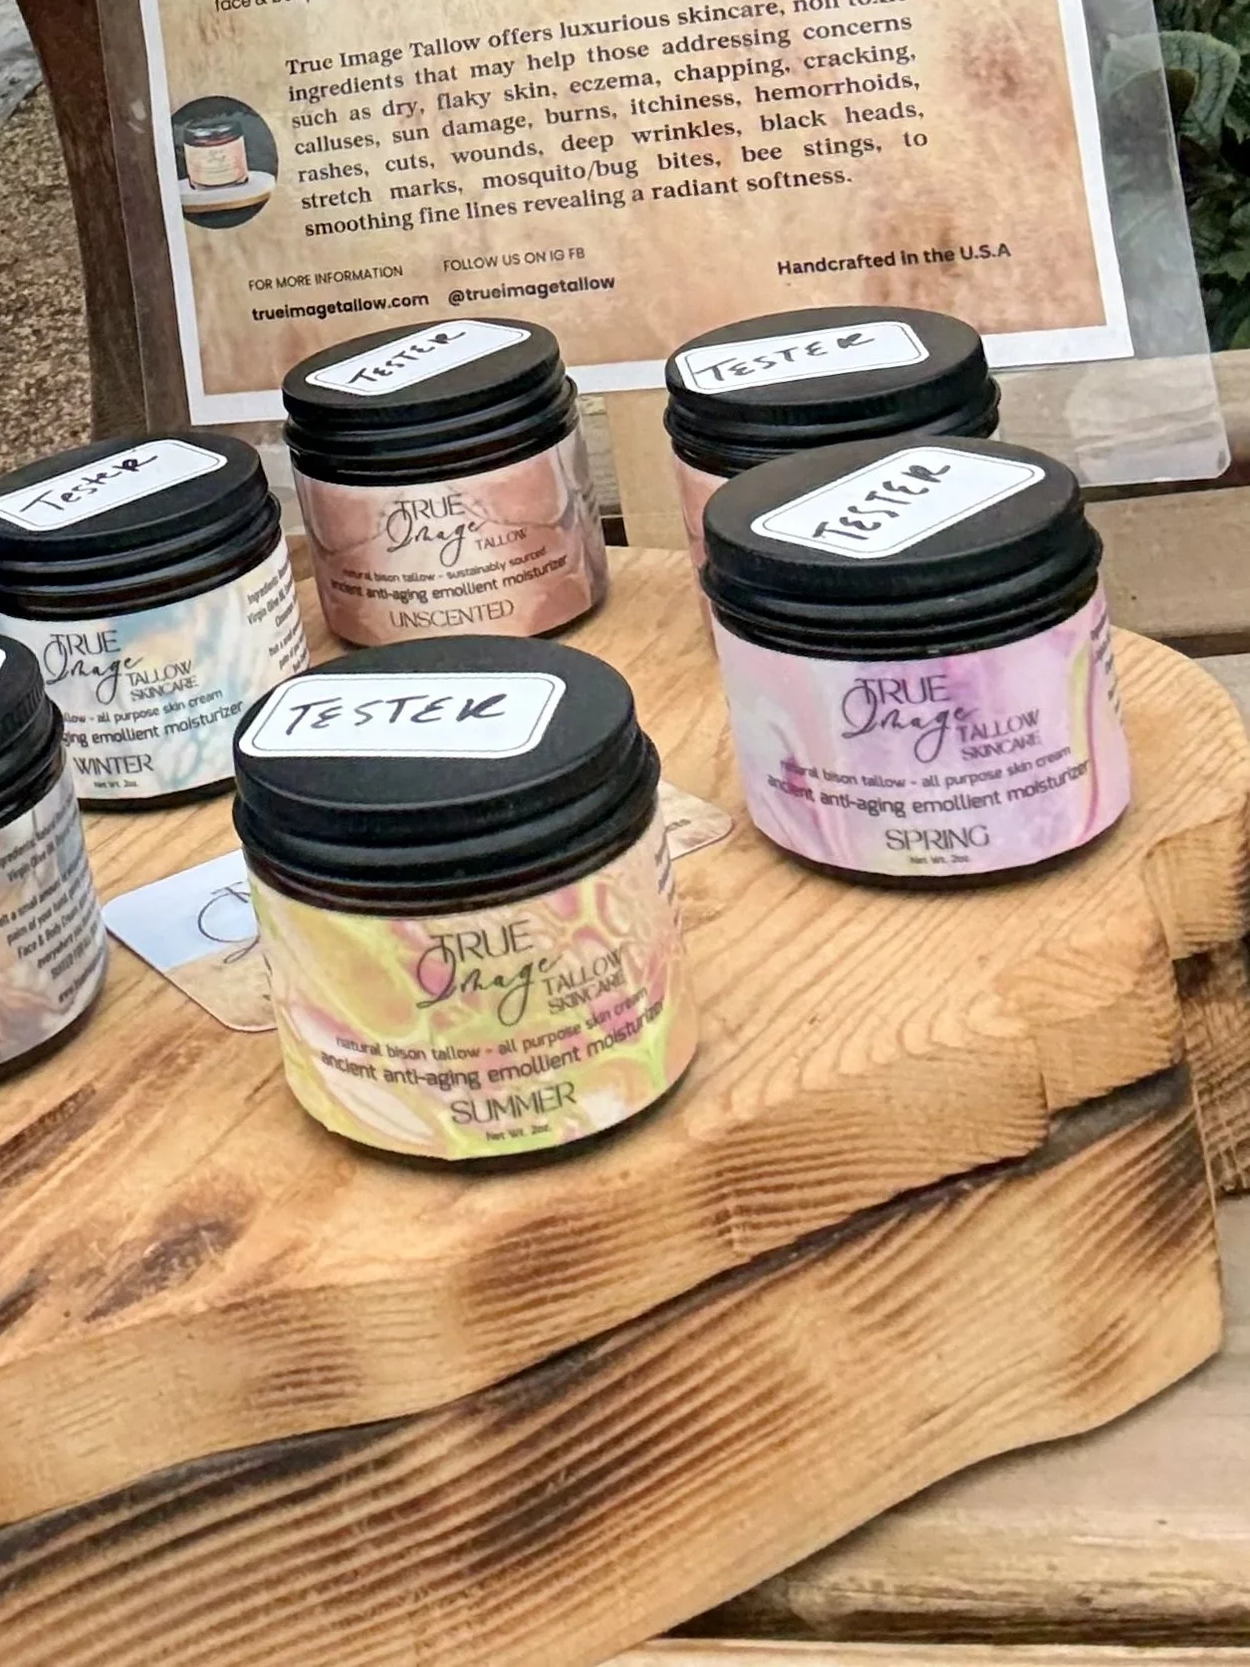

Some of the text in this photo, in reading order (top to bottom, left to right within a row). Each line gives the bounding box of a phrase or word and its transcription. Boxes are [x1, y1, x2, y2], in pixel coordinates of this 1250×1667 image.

[285, 58, 332, 75] True
[339, 48, 402, 67] Image
[409, 37, 480, 58] Tallow
[488, 27, 553, 48] offers
[559, 14, 670, 39] luxurious
[677, 2, 785, 25] skincare,
[289, 17, 912, 104] ingredients that may help those addressing concerns
[292, 45, 915, 129] such as dry, flaky skin, eczema, chapping, cracking,
[294, 72, 919, 155] calluses, sun damage, burns, itchiness, hemorrhoids,
[298, 101, 924, 182] rashes, cuts, wounds, deep wrinkles, black heads,
[301, 132, 927, 209] stretch marks, mosquito/bug bites, bee stings, to
[305, 170, 852, 236] smoothing fine lines revealing a radiant softness.
[777, 243, 1011, 275] Handcrafted in the U.S.A
[252, 293, 430, 321] trueimagetallow.com
[448, 275, 616, 307] @trueimagetallow
[346, 330, 467, 384] TESTER
[696, 332, 876, 381] TESTER
[395, 493, 466, 522] TRUE
[813, 463, 951, 540] TESTER
[475, 528, 528, 551] TALLOW
[389, 598, 514, 629] UNSCENTED
[50, 630, 121, 656] TRUE
[126, 660, 193, 687] TALLOW
[130, 675, 200, 702] SKINCARE
[854, 674, 950, 706] TRUE
[289, 692, 508, 736] TESTER
[956, 710, 1040, 743] TALLOW
[72, 753, 154, 777] WINTER
[961, 732, 1042, 762] SKINCARE
[820, 787, 906, 818] anti-aging
[912, 790, 1001, 816] emollient
[1006, 760, 1090, 802] moisturizer
[885, 824, 990, 851] SPRING
[431, 920, 533, 964] TRUE
[541, 947, 625, 995] TALLOW
[548, 972, 626, 1015] SKINCARE
[321, 996, 664, 1092] ancient anti-aging emollient moisturizer
[336, 988, 648, 1061] natural bison tallow all purpose skin cream
[450, 1080, 578, 1126] SUMMER
